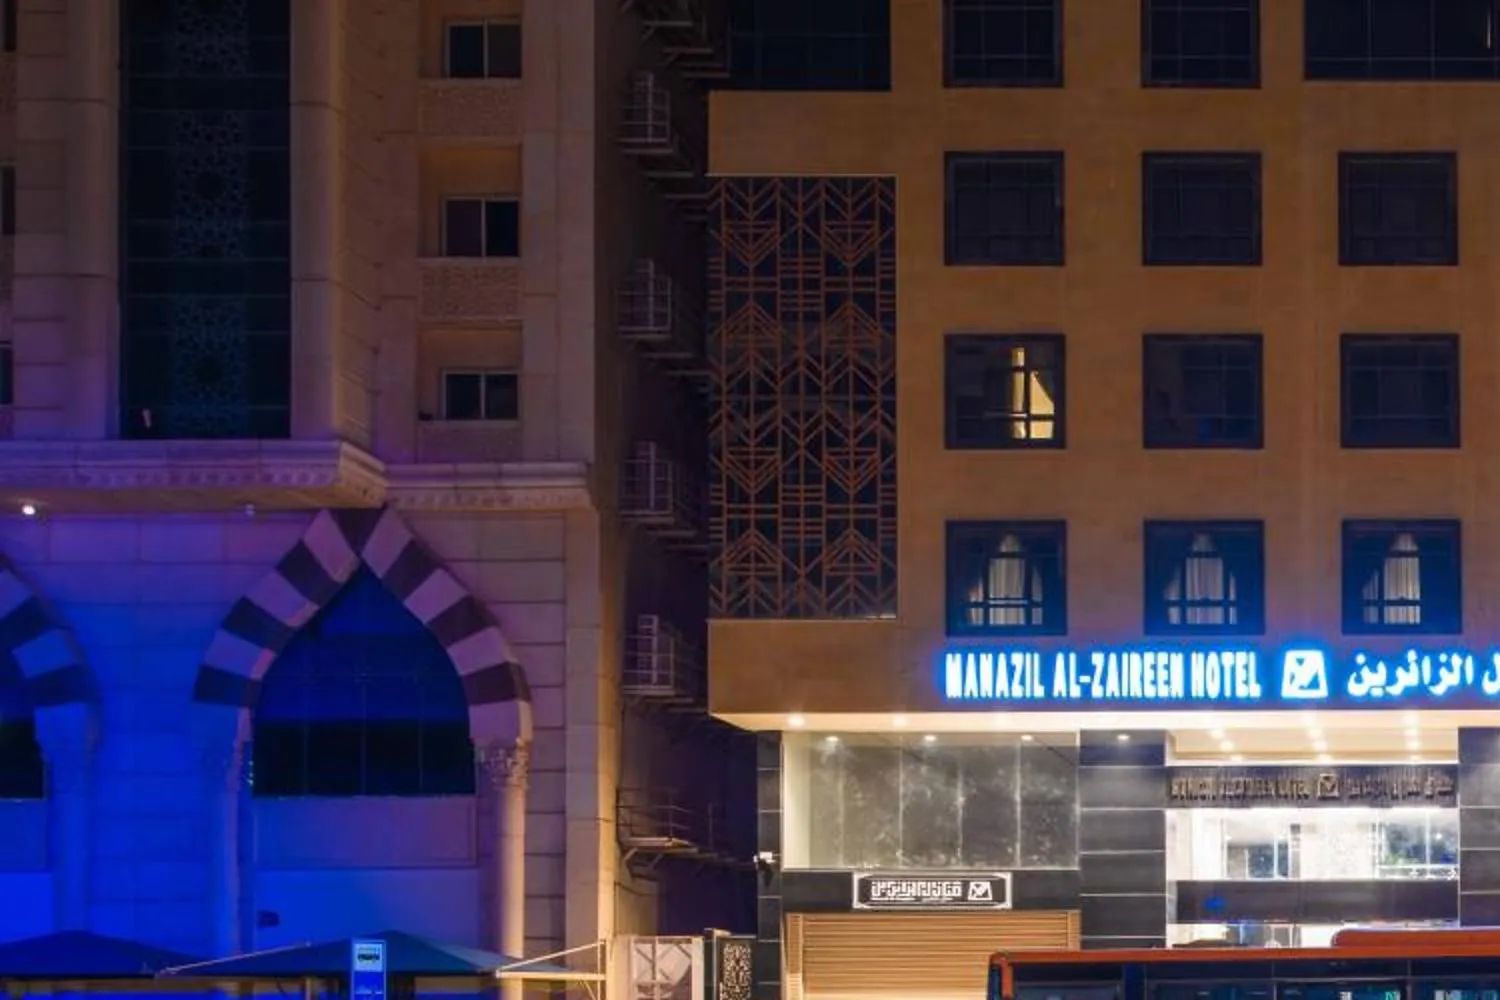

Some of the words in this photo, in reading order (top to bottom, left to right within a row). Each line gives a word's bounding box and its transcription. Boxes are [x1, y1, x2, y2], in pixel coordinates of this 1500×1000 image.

[945, 652, 1045, 698] MANAZIL
[1052, 652, 1185, 698] AL-ZAIREEN
[1190, 651, 1262, 698] HOTEL
[1347, 648, 1474, 697] الزائرين
